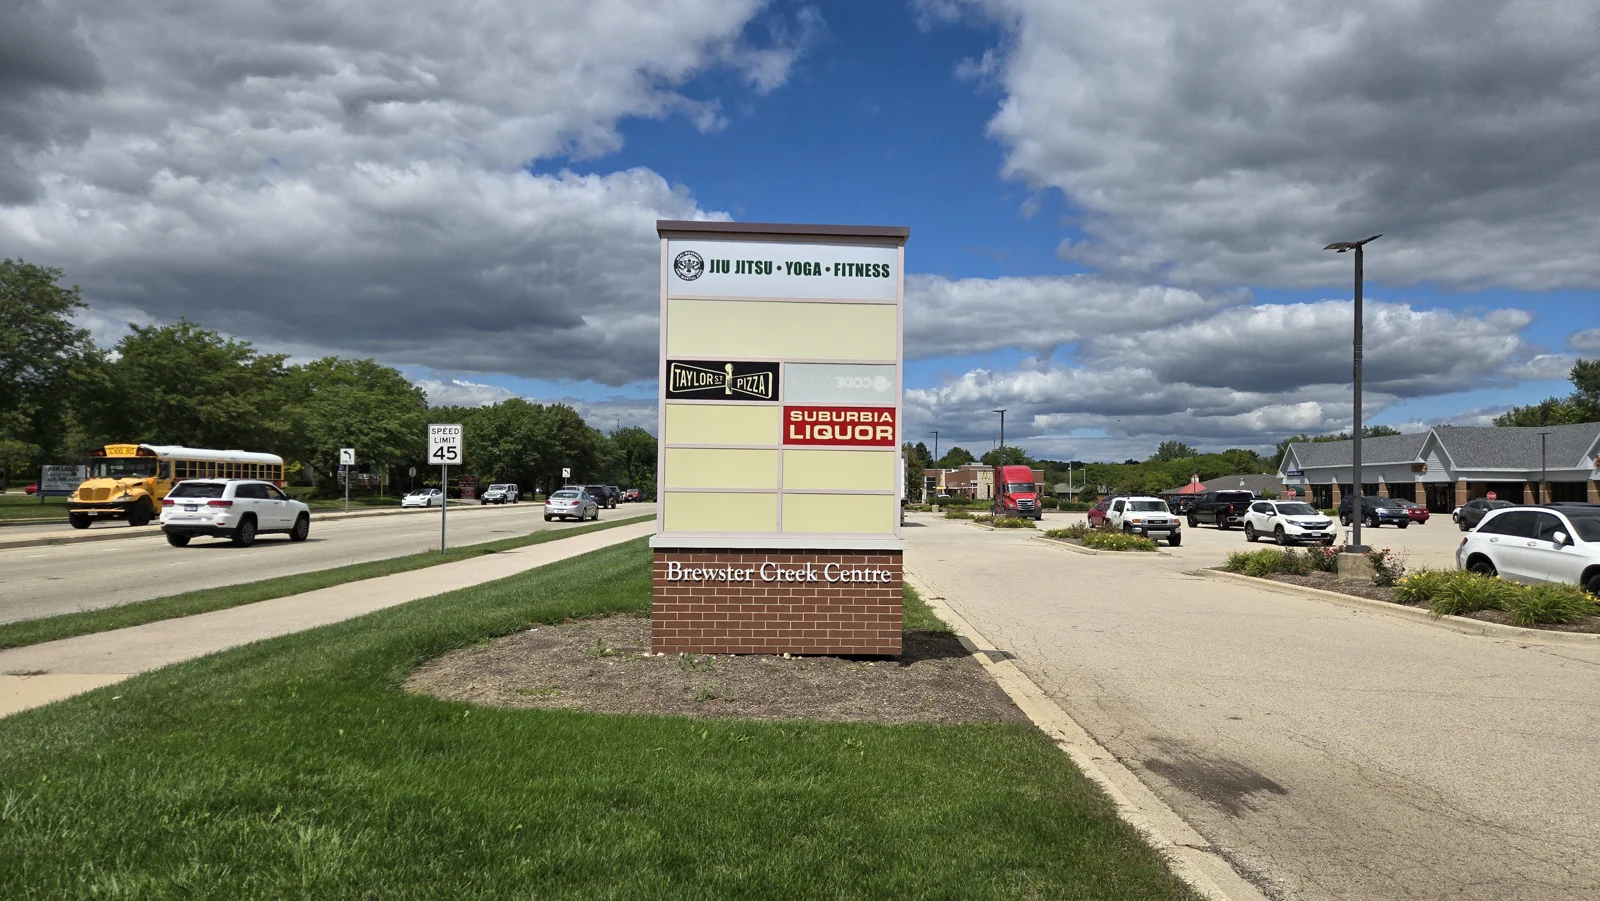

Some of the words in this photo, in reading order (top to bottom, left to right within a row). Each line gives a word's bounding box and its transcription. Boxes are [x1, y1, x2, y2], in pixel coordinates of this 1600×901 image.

[709, 259, 730, 274] JIU
[734, 260, 773, 275] JITSU
[785, 261, 822, 276] YOGA
[834, 262, 890, 278] FITNESS
[675, 368, 713, 387] TAYLOR
[737, 375, 766, 394] PIZZA
[790, 410, 893, 423] SUBURBIA
[431, 427, 460, 435] SPEED
[789, 424, 893, 441] LIQUOR
[107, 447, 123, 455] SCHOOL
[432, 446, 458, 461] 45
[667, 561, 754, 582] Brewster
[760, 561, 818, 582] Creek
[824, 562, 891, 583] Centre
